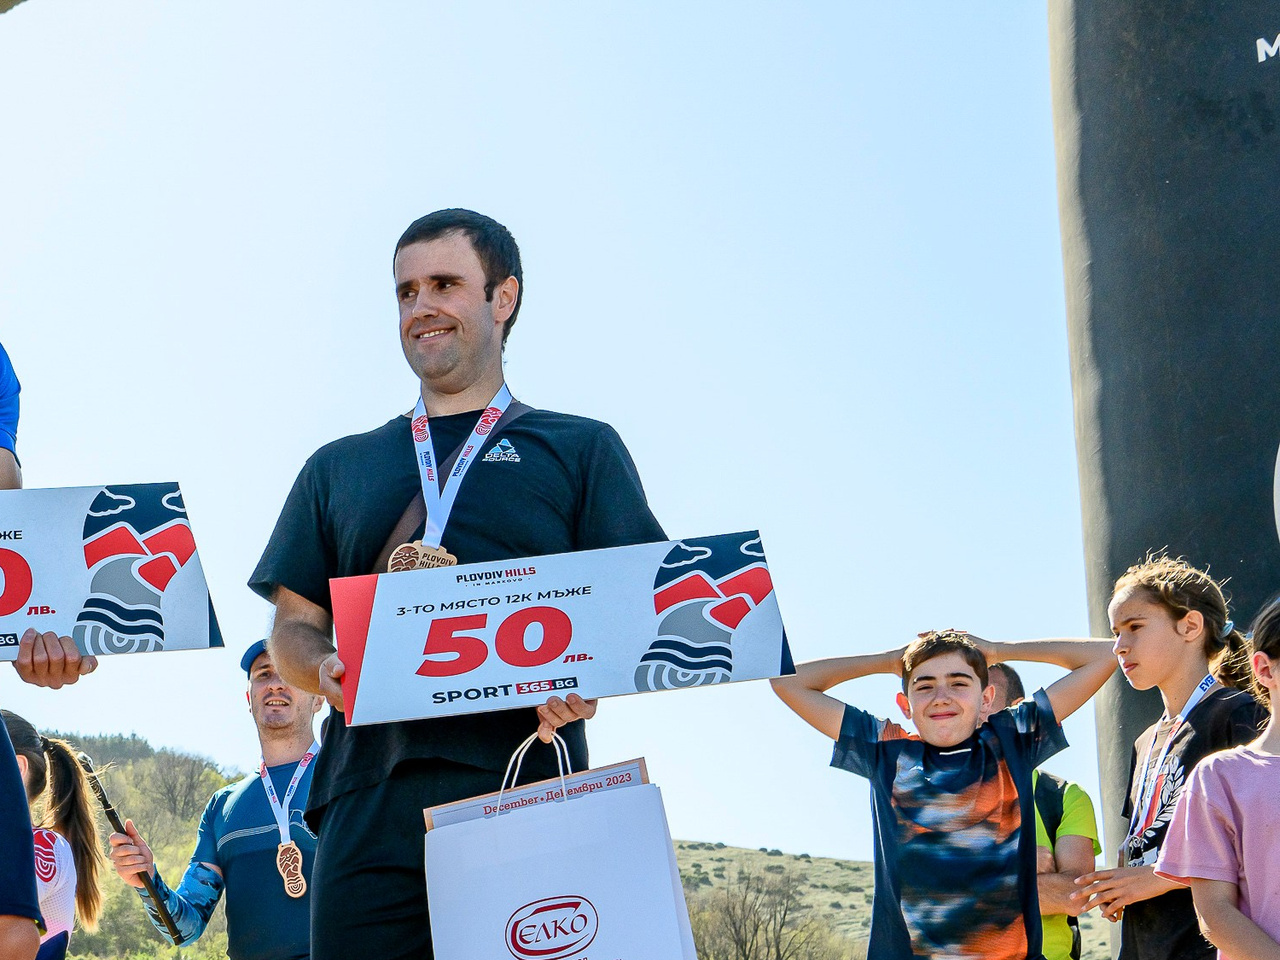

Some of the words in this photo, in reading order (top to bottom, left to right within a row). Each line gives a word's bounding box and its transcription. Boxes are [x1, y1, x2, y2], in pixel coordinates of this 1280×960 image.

[422, 552, 454, 566] PLOVDIV
[456, 570, 503, 583] PLOVDIV
[505, 566, 536, 578] HILLS
[396, 603, 435, 616] 3-ТО
[440, 596, 501, 612] МЯСТО
[537, 585, 592, 601] МЪЖЕ
[415, 606, 573, 678] 50
[432, 683, 513, 704] SPORT
[518, 679, 575, 694] 365.BG
[605, 772, 632, 787] 2023
